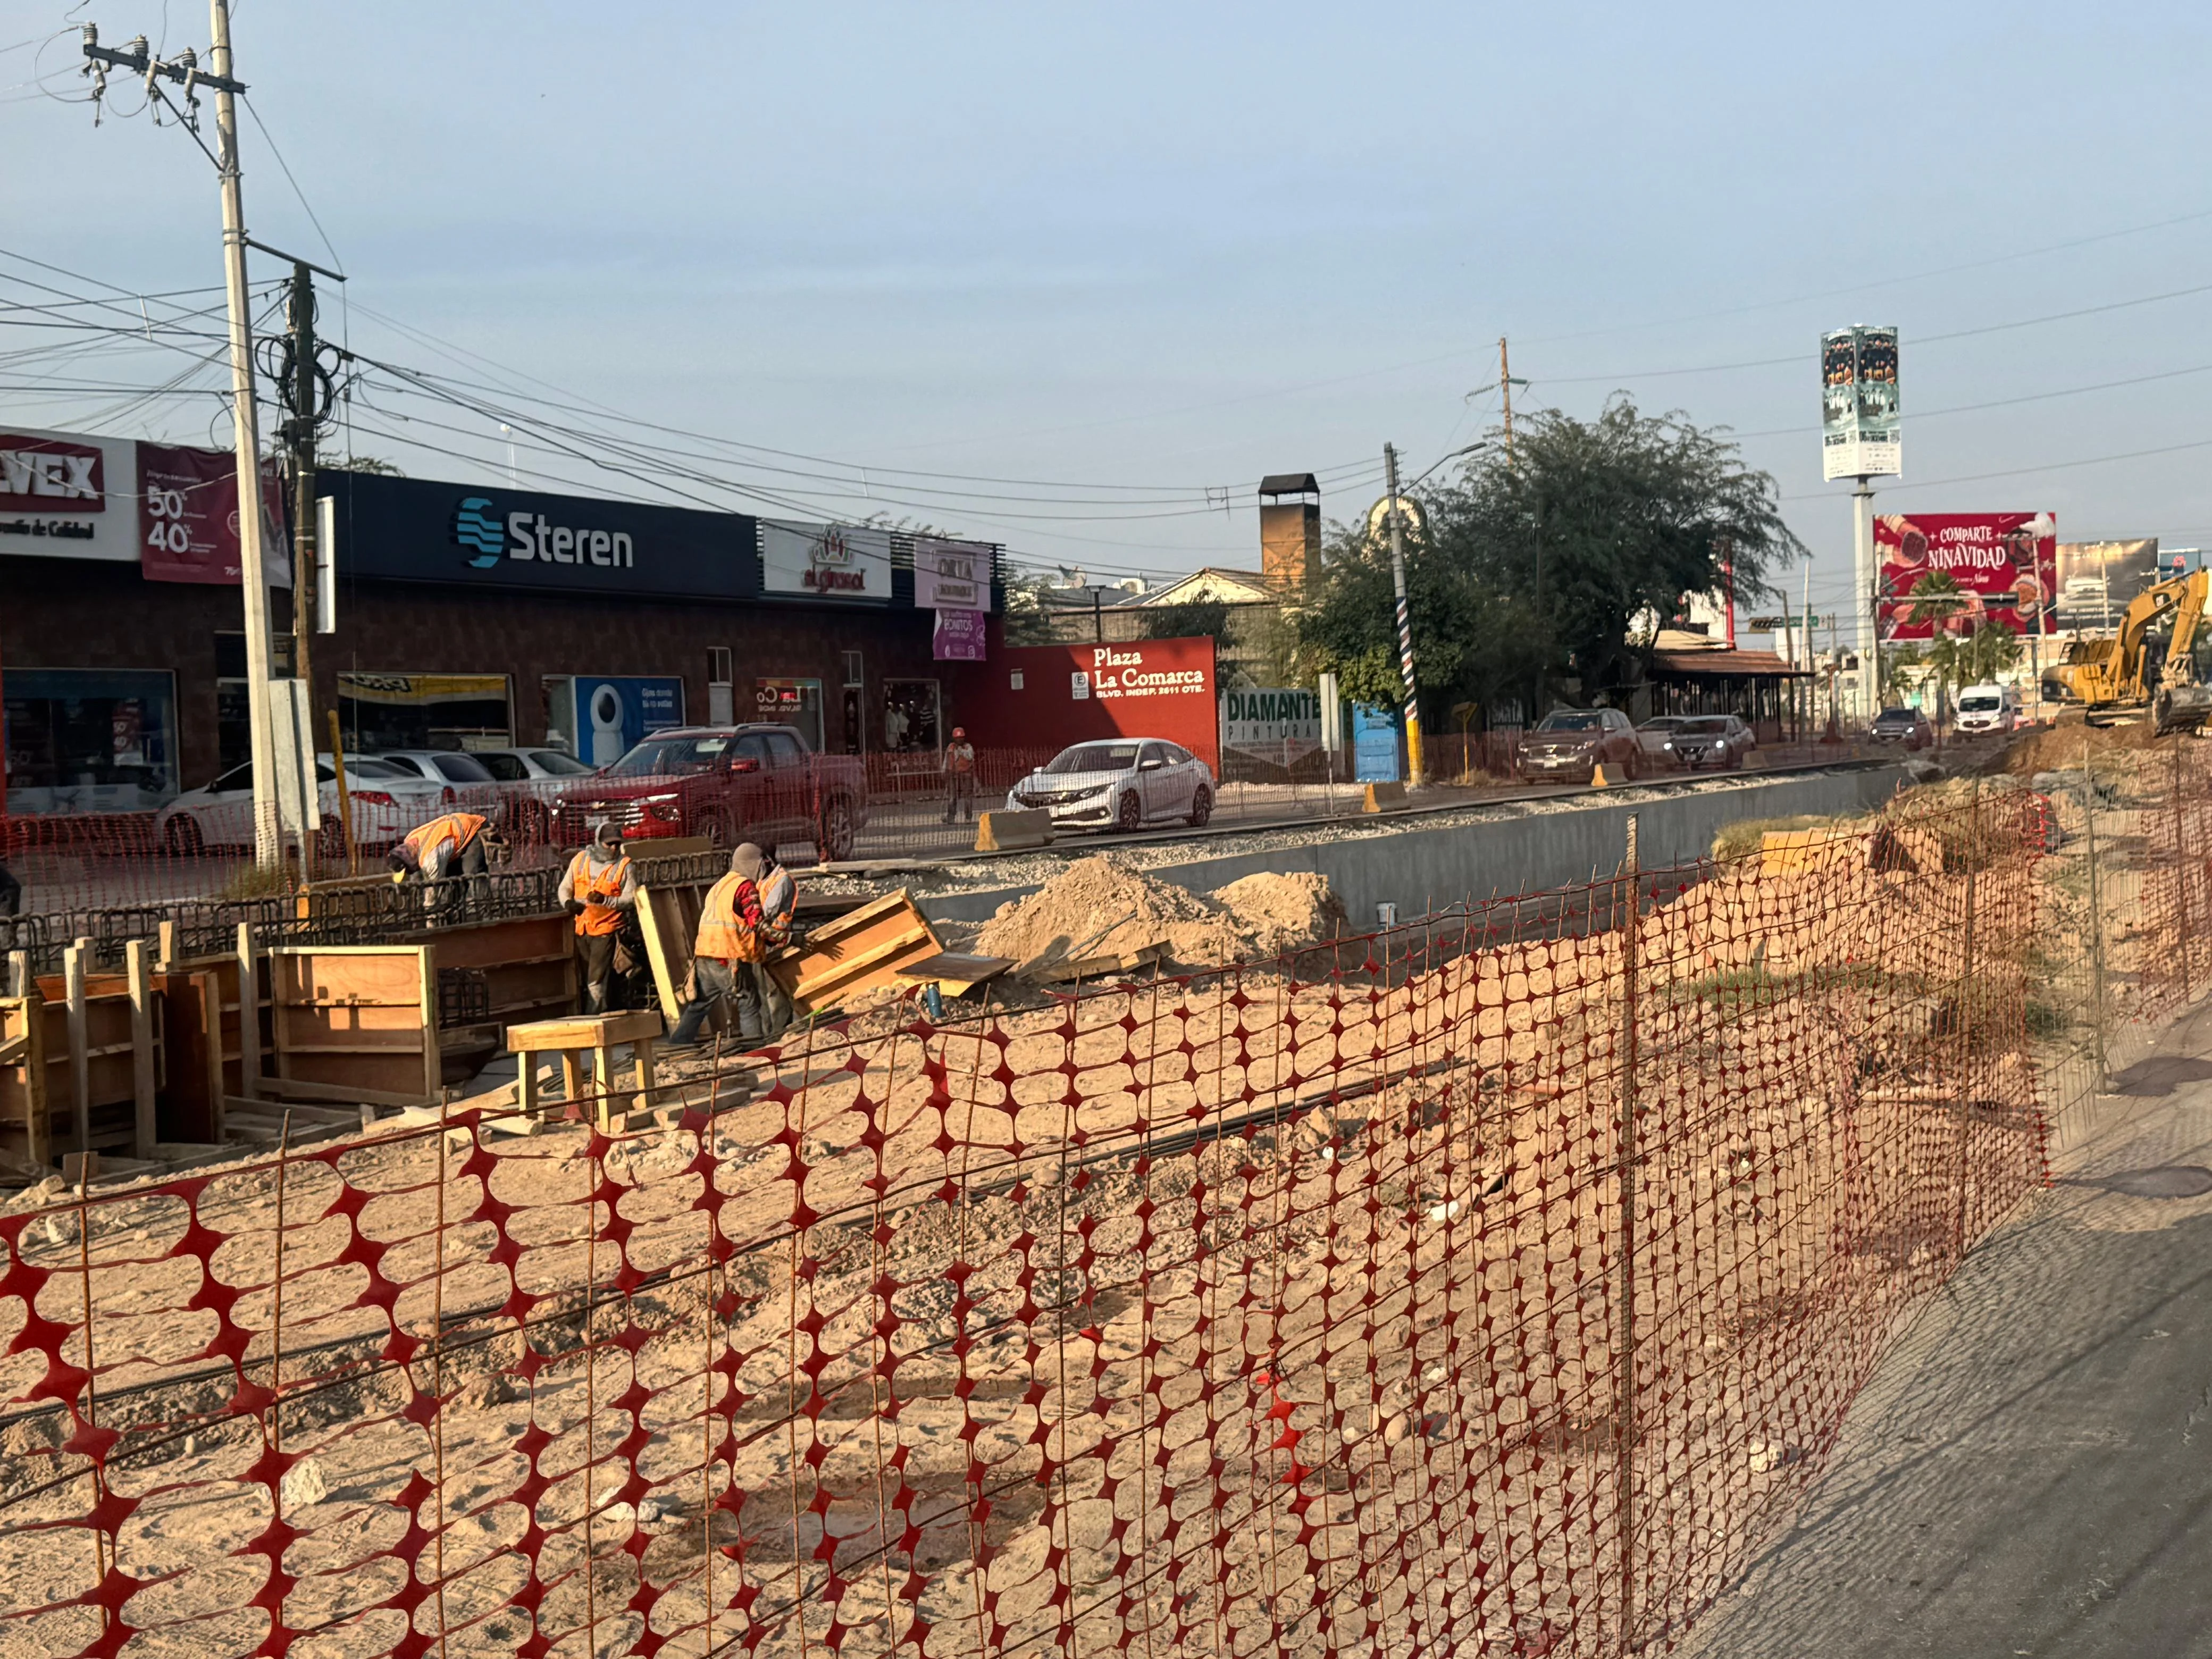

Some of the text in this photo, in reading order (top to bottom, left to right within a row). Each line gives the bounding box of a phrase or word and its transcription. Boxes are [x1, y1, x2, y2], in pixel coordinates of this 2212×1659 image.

[0, 449, 99, 500] VEX
[508, 512, 633, 567] Steren
[1940, 525, 1993, 543] COMPARTE
[1928, 542, 2006, 571] NINAVIDAD
[1093, 647, 1143, 667] Plaza
[1094, 668, 1204, 689] La Comarca
[1126, 688, 1157, 697] INDEP.
[1227, 693, 1321, 722] DIAMANTE
